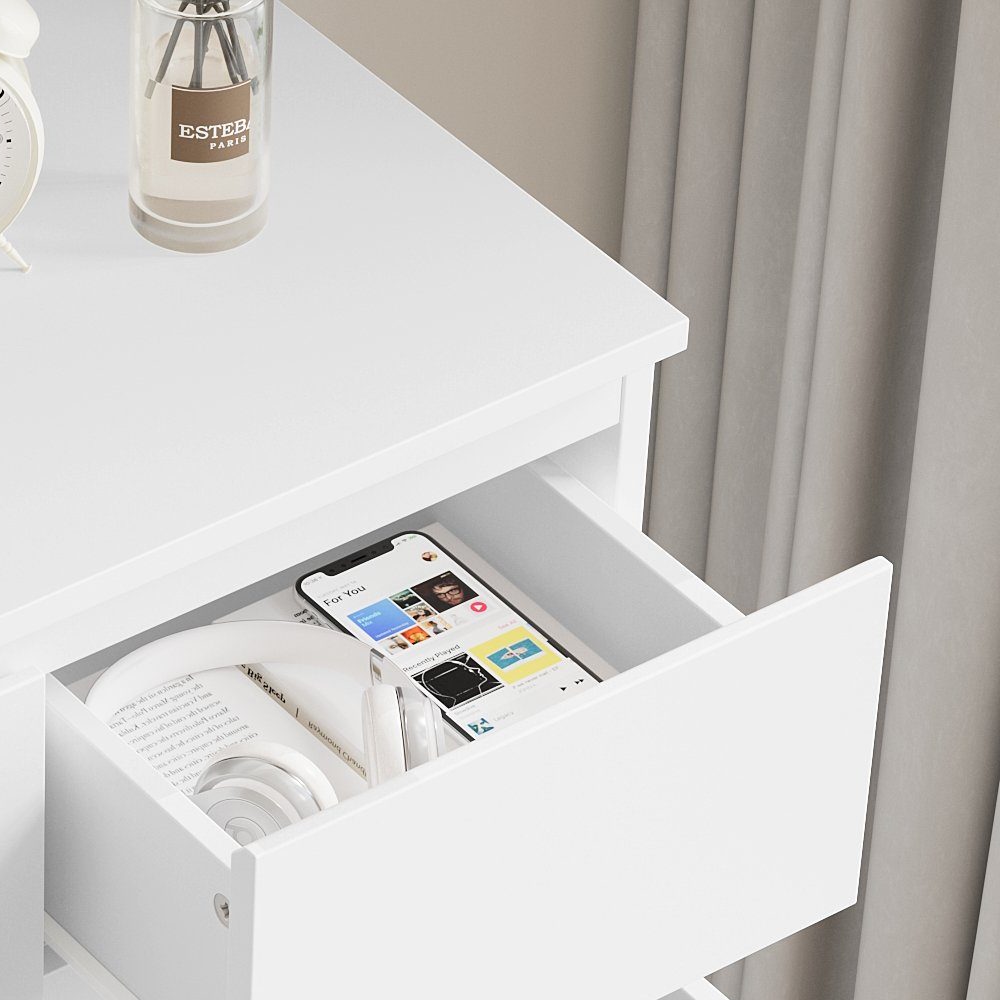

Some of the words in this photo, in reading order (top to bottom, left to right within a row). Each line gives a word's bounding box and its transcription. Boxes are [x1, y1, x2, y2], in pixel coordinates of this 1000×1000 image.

[209, 135, 247, 150] PARIS
[323, 596, 343, 607] For
[343, 585, 367, 598] You
